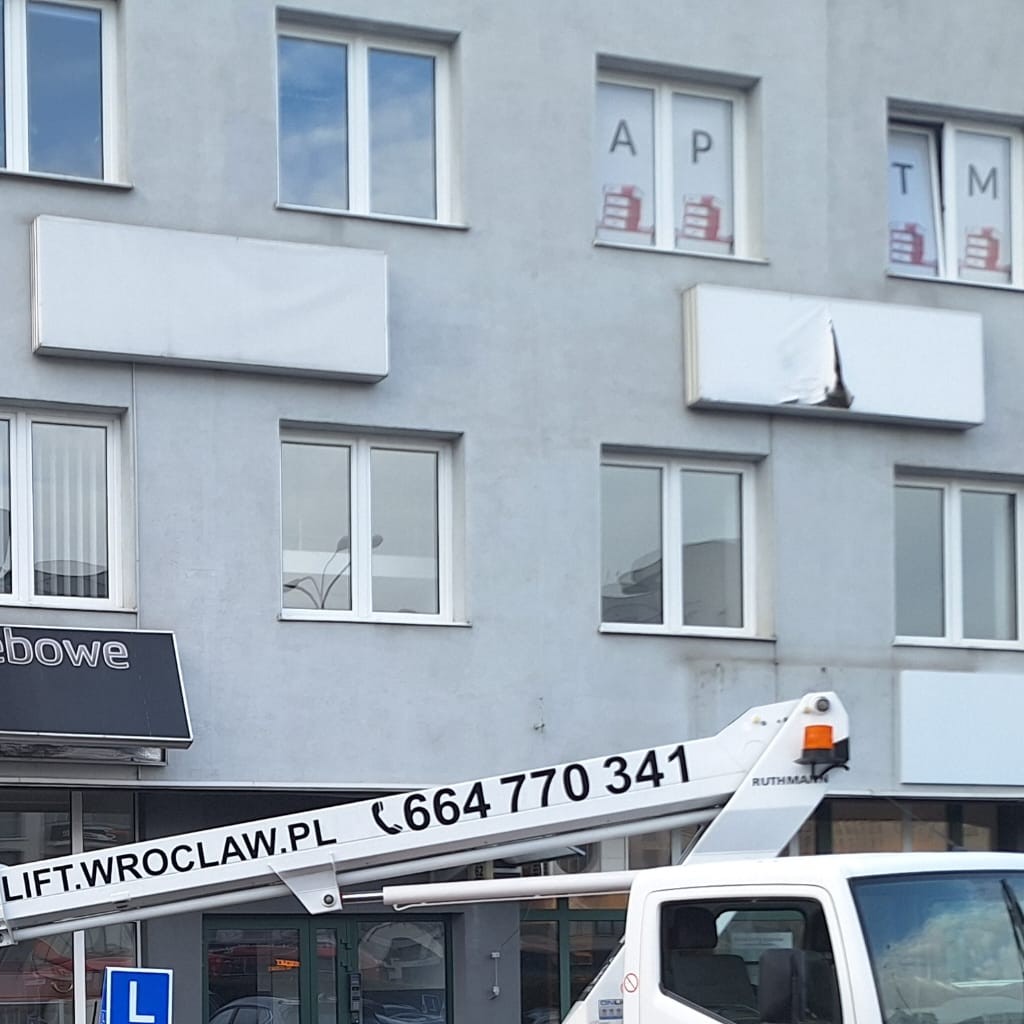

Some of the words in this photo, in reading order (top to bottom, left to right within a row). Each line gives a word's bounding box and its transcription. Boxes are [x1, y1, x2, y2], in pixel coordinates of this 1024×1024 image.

[608, 119, 637, 156] A
[692, 129, 713, 164] P
[891, 161, 914, 195] T
[968, 163, 998, 199] M
[1, 819, 337, 902] LIFT.WROCLAW.PL
[403, 782, 491, 832] 664
[501, 763, 591, 814] 770
[603, 745, 690, 796] 341
[128, 980, 155, 1024] L
